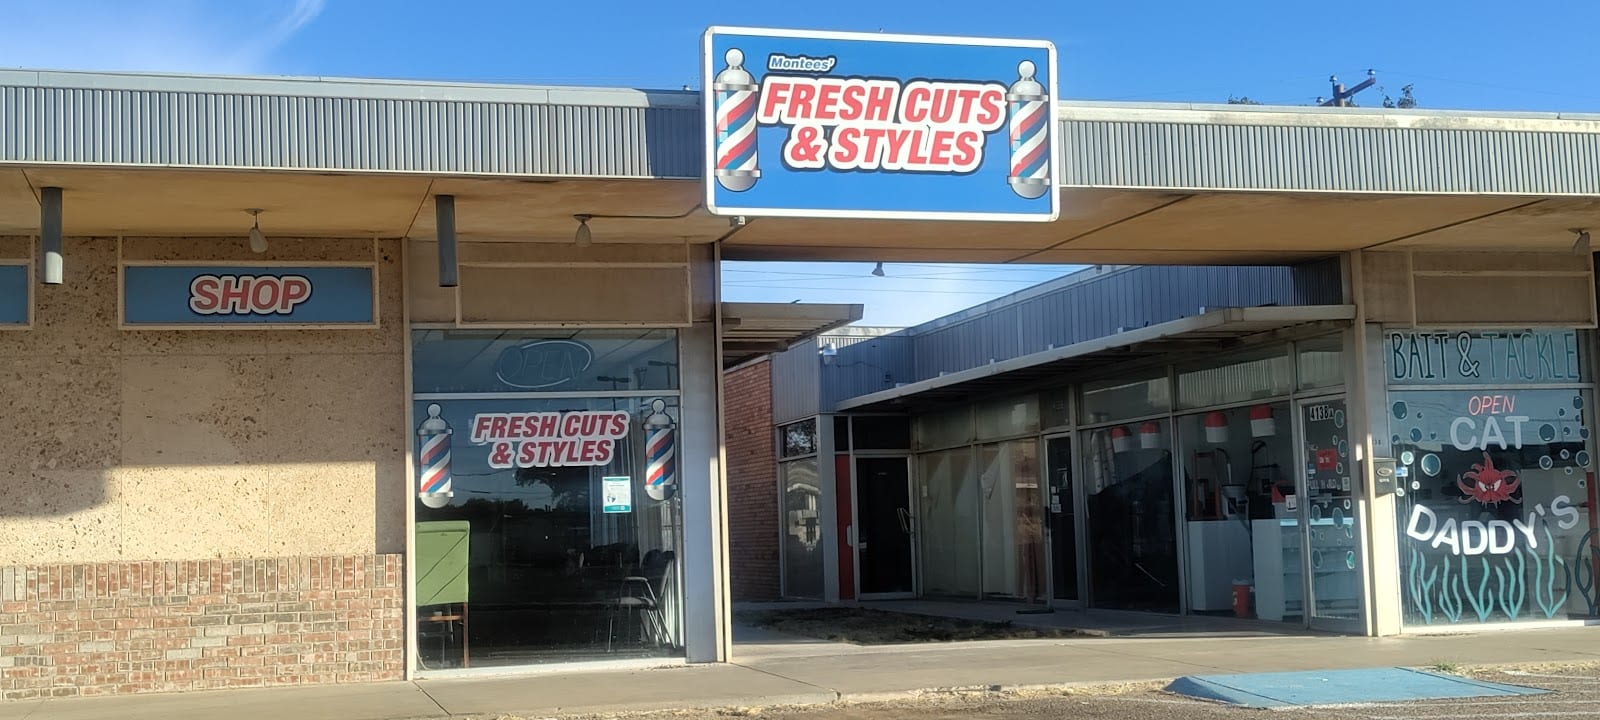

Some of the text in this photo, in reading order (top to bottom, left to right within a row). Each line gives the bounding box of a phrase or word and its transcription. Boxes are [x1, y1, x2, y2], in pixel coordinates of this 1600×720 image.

[771, 56, 835, 71] Montees'
[763, 83, 1004, 125] FRESH CUTS
[791, 127, 979, 166] & STYLES
[194, 279, 308, 310] SHOP
[1391, 331, 1580, 381] BAIT & TACKLE
[1468, 395, 1516, 416] OPEN
[474, 413, 627, 439] FRESH CUTS
[1450, 415, 1530, 451] CAT
[492, 440, 612, 465] & STYLES
[1406, 495, 1580, 556] DADDY'S
